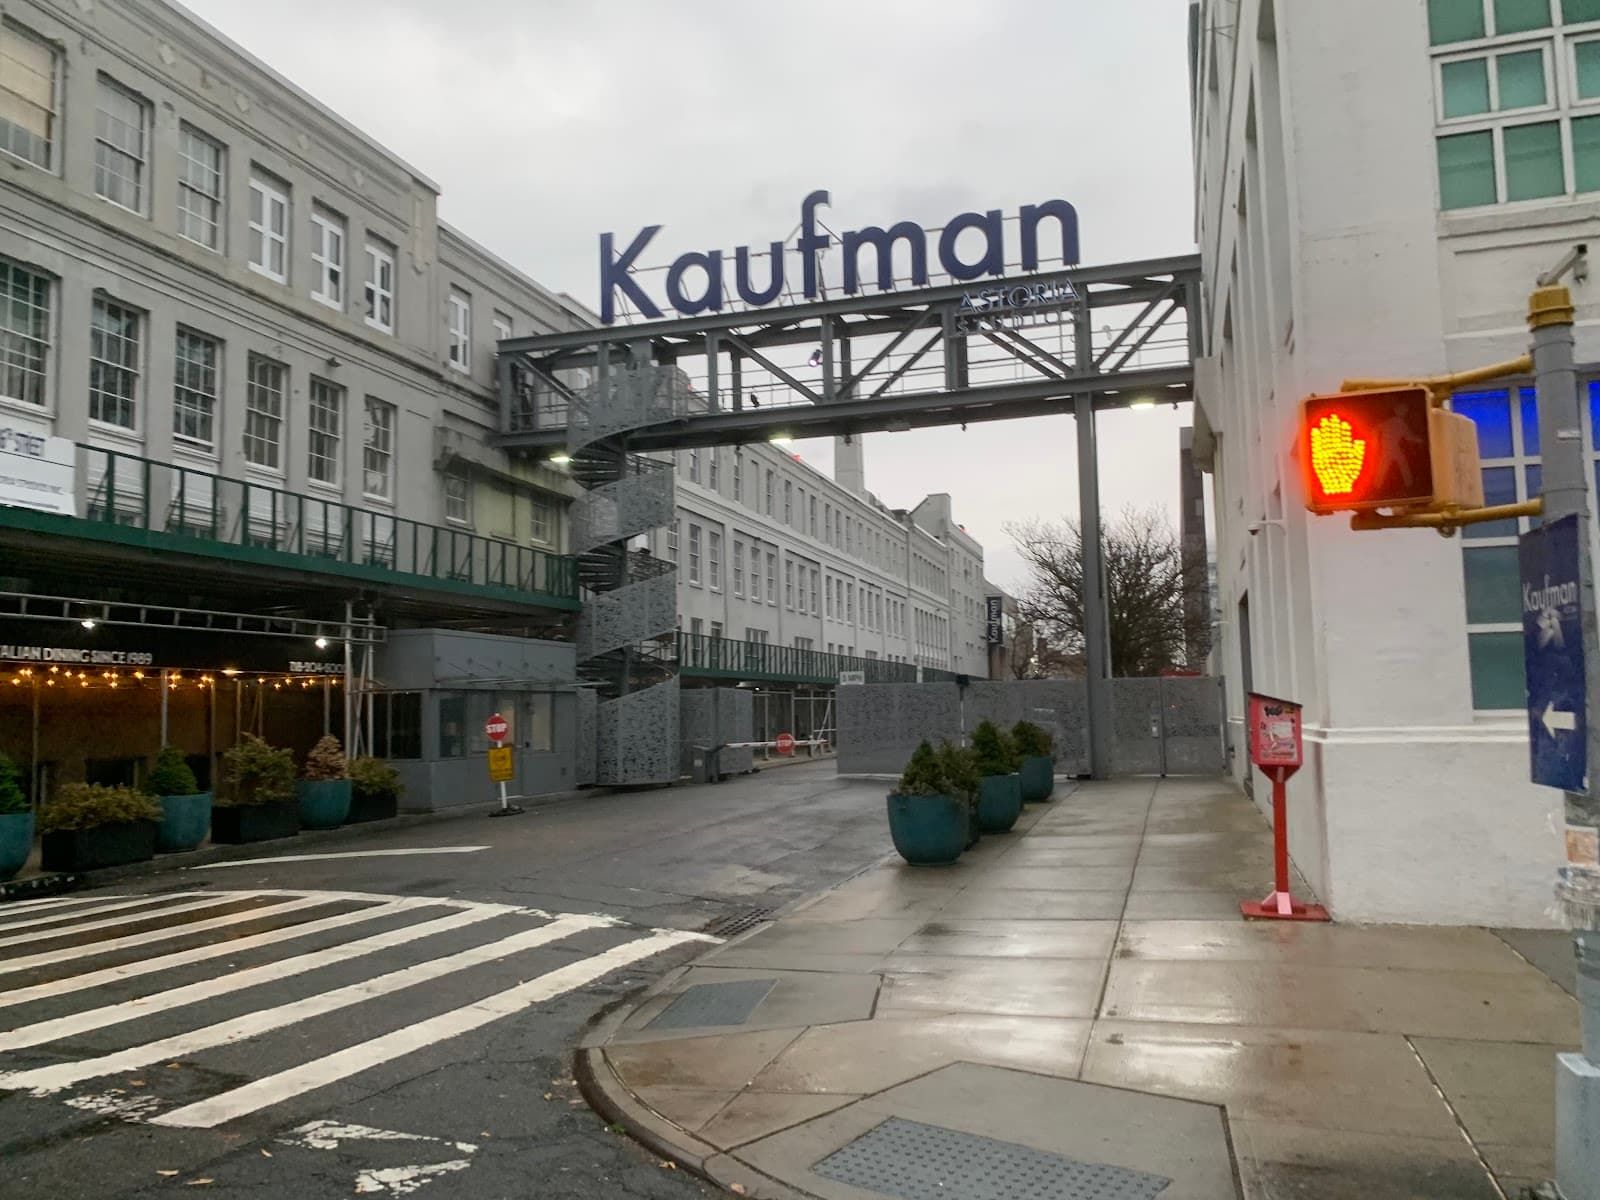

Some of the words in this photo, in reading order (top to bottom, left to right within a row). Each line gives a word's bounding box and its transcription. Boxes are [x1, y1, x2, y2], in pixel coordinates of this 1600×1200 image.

[600, 189, 1080, 324] Kaufman
[960, 278, 1080, 313] ASTORIA
[1522, 574, 1577, 612] Kaufman
[989, 600, 1000, 642] Kaufman
[43, 648, 90, 662] DINING
[91, 650, 126, 663] SINCE
[486, 723, 507, 733] STOP
